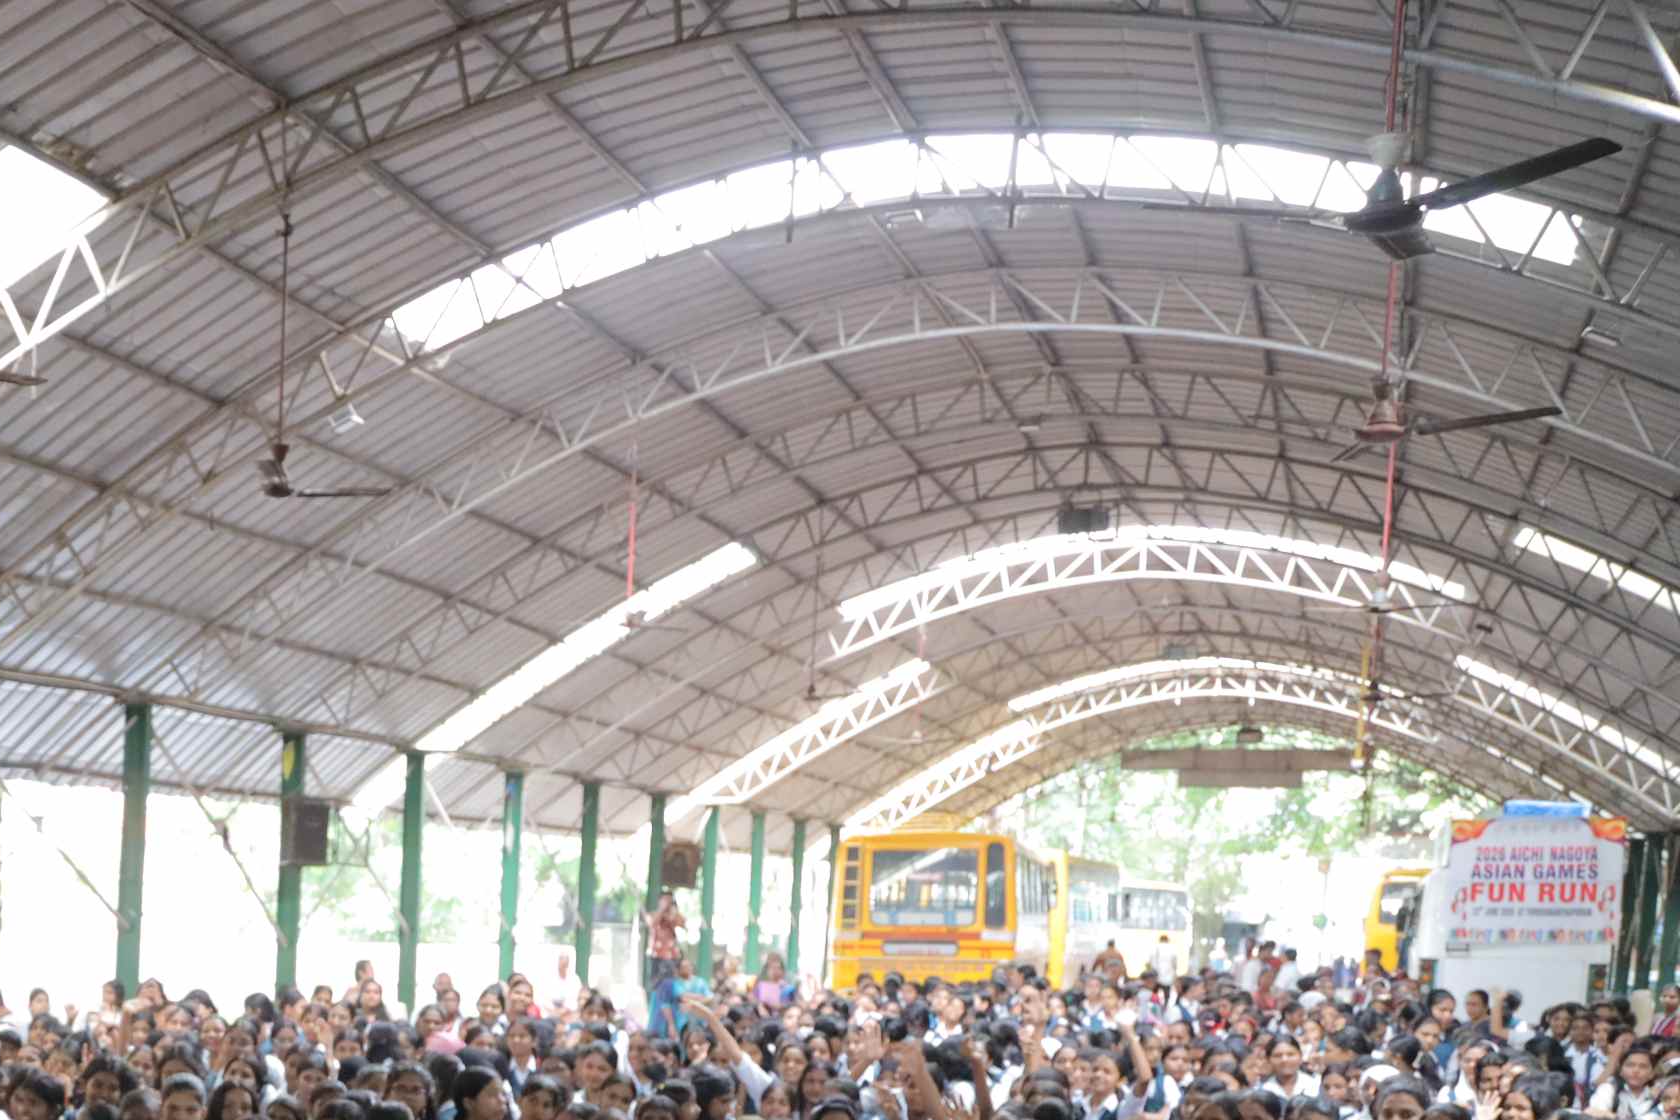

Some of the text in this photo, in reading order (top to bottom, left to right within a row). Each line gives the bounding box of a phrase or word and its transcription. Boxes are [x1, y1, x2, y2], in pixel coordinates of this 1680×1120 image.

[1510, 846, 1543, 861] AICHI
[1551, 846, 1599, 861] NAGOYA
[1471, 863, 1599, 879] ASIAN GAMES
[1470, 881, 1598, 903] FUN RUN
